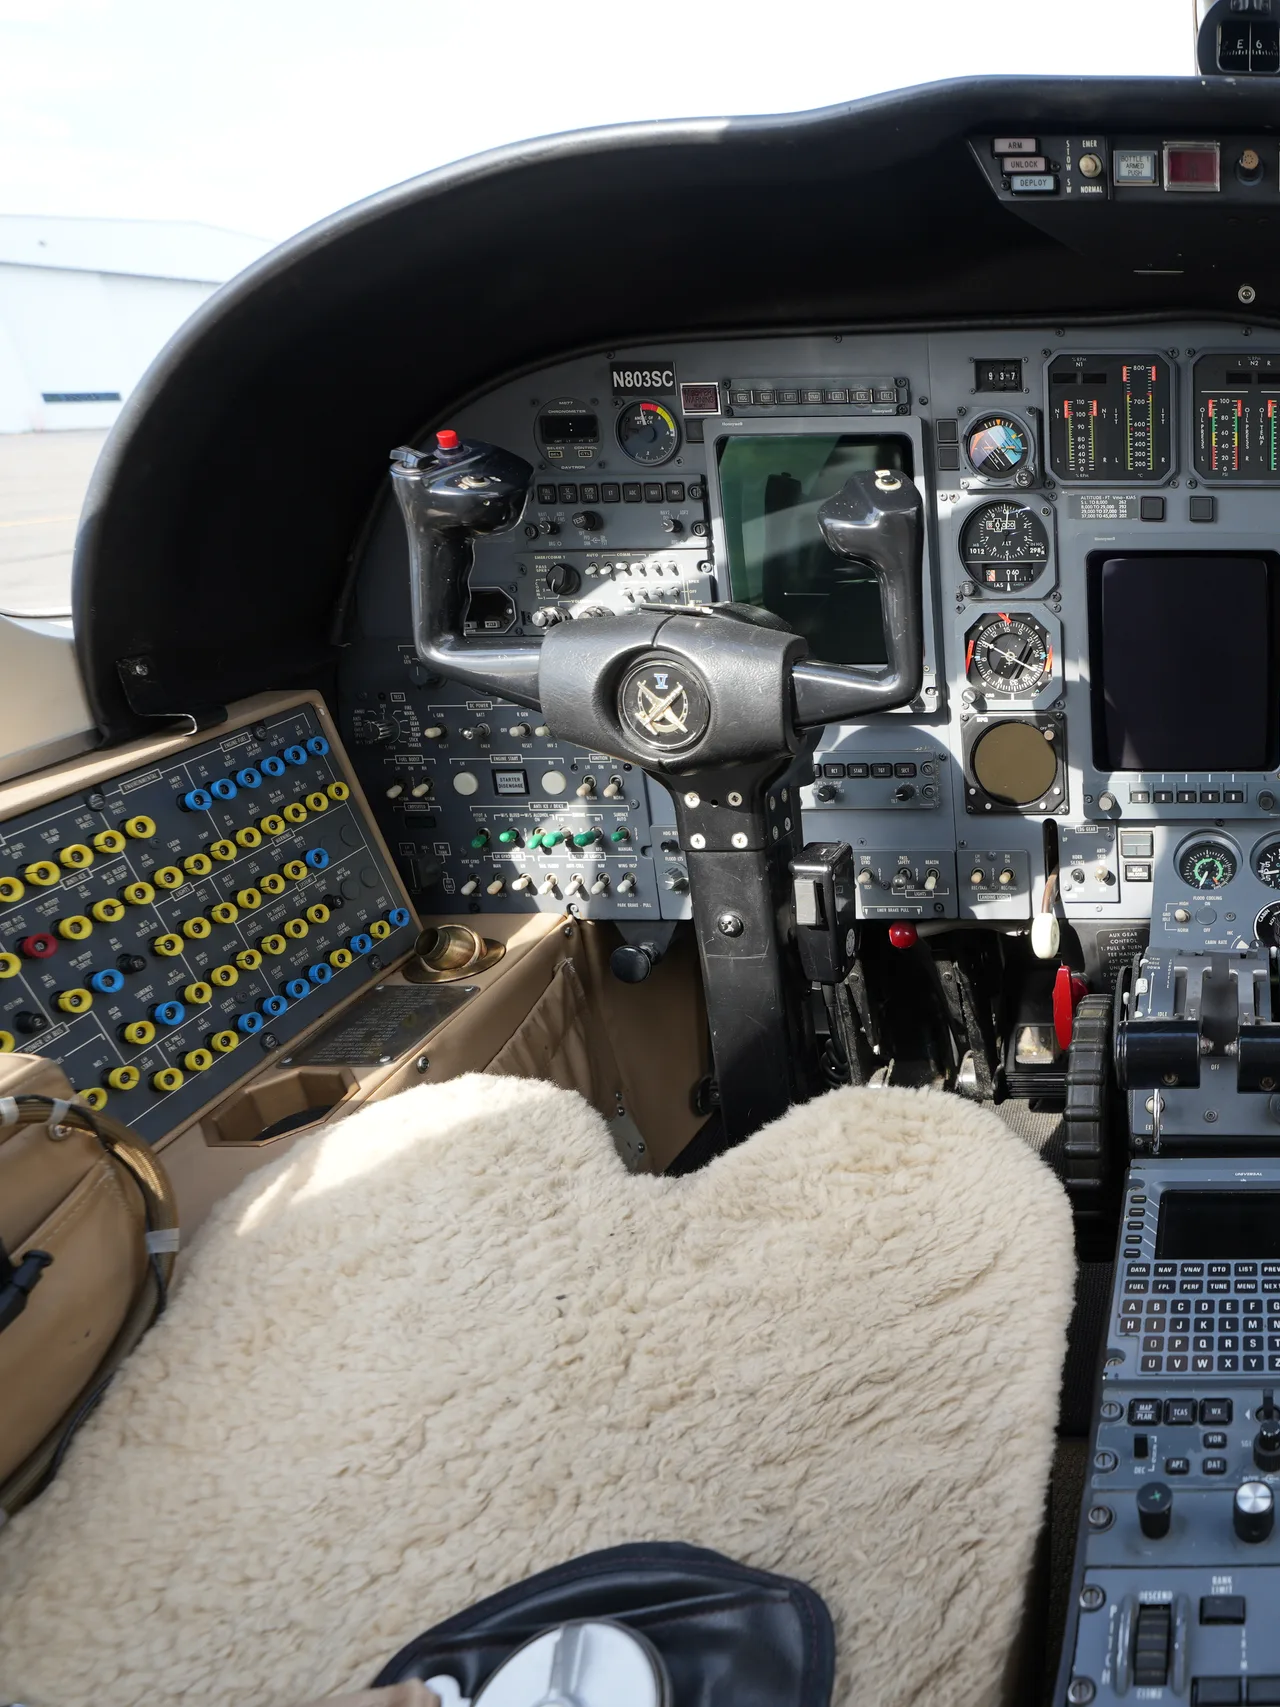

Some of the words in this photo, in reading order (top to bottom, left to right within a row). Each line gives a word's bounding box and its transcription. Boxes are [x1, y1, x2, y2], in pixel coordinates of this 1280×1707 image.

[1237, 39, 1243, 49] E
[1256, 40, 1262, 49] 6
[613, 370, 673, 387] N803SC
[1176, 1321, 1182, 1329] J
[1226, 1321, 1231, 1329] L
[1175, 1340, 1181, 1348] P
[1200, 1340, 1206, 1348] Q
[1250, 1339, 1256, 1347] S
[1275, 1339, 1280, 1347] T
[1149, 1360, 1155, 1368] U
[1174, 1359, 1181, 1368] V
[1198, 1359, 1208, 1368] W
[1225, 1359, 1231, 1368] X
[1250, 1359, 1256, 1367] Y
[1212, 1585, 1232, 1593] LIMIT
